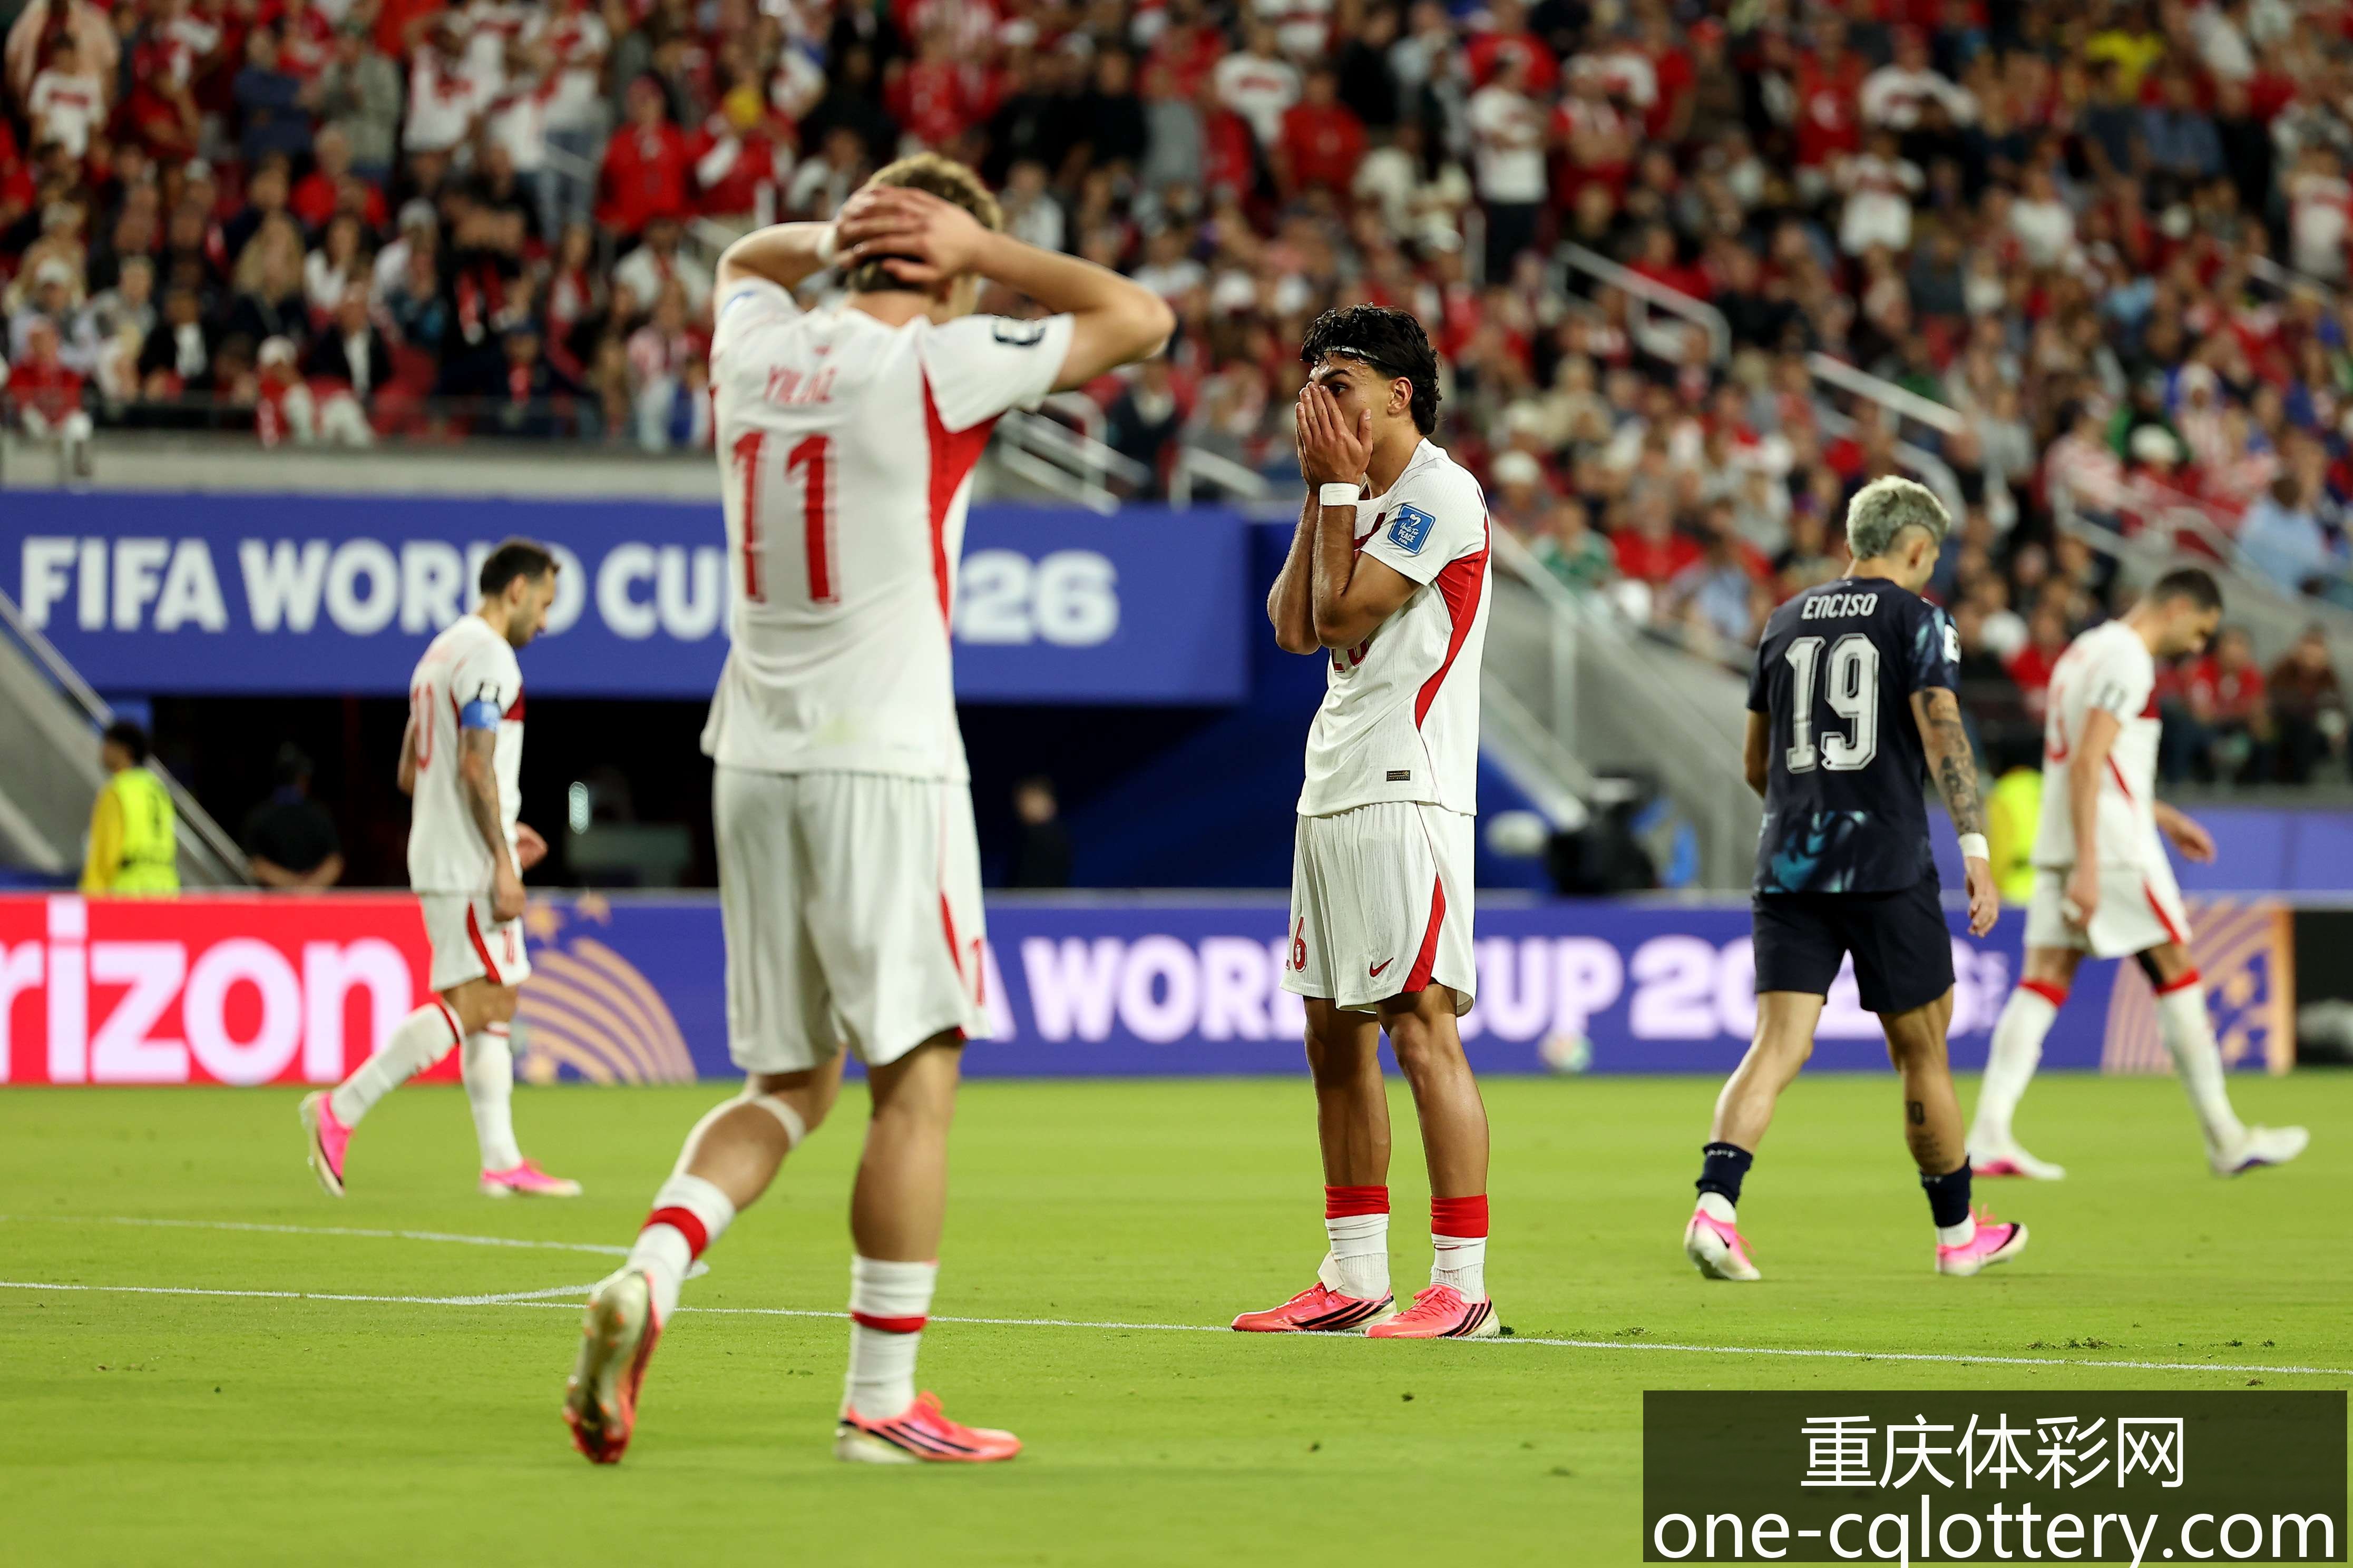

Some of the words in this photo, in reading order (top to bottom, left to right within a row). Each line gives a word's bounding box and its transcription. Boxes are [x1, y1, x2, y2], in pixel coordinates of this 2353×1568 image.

[732, 429, 839, 605] 11
[1398, 529, 1415, 543] PEACE
[21, 535, 228, 632] FIFA
[594, 540, 729, 642] CU
[1801, 593, 1879, 620] ENCISO
[1785, 632, 1880, 775] 19
[1286, 916, 1307, 973] 6
